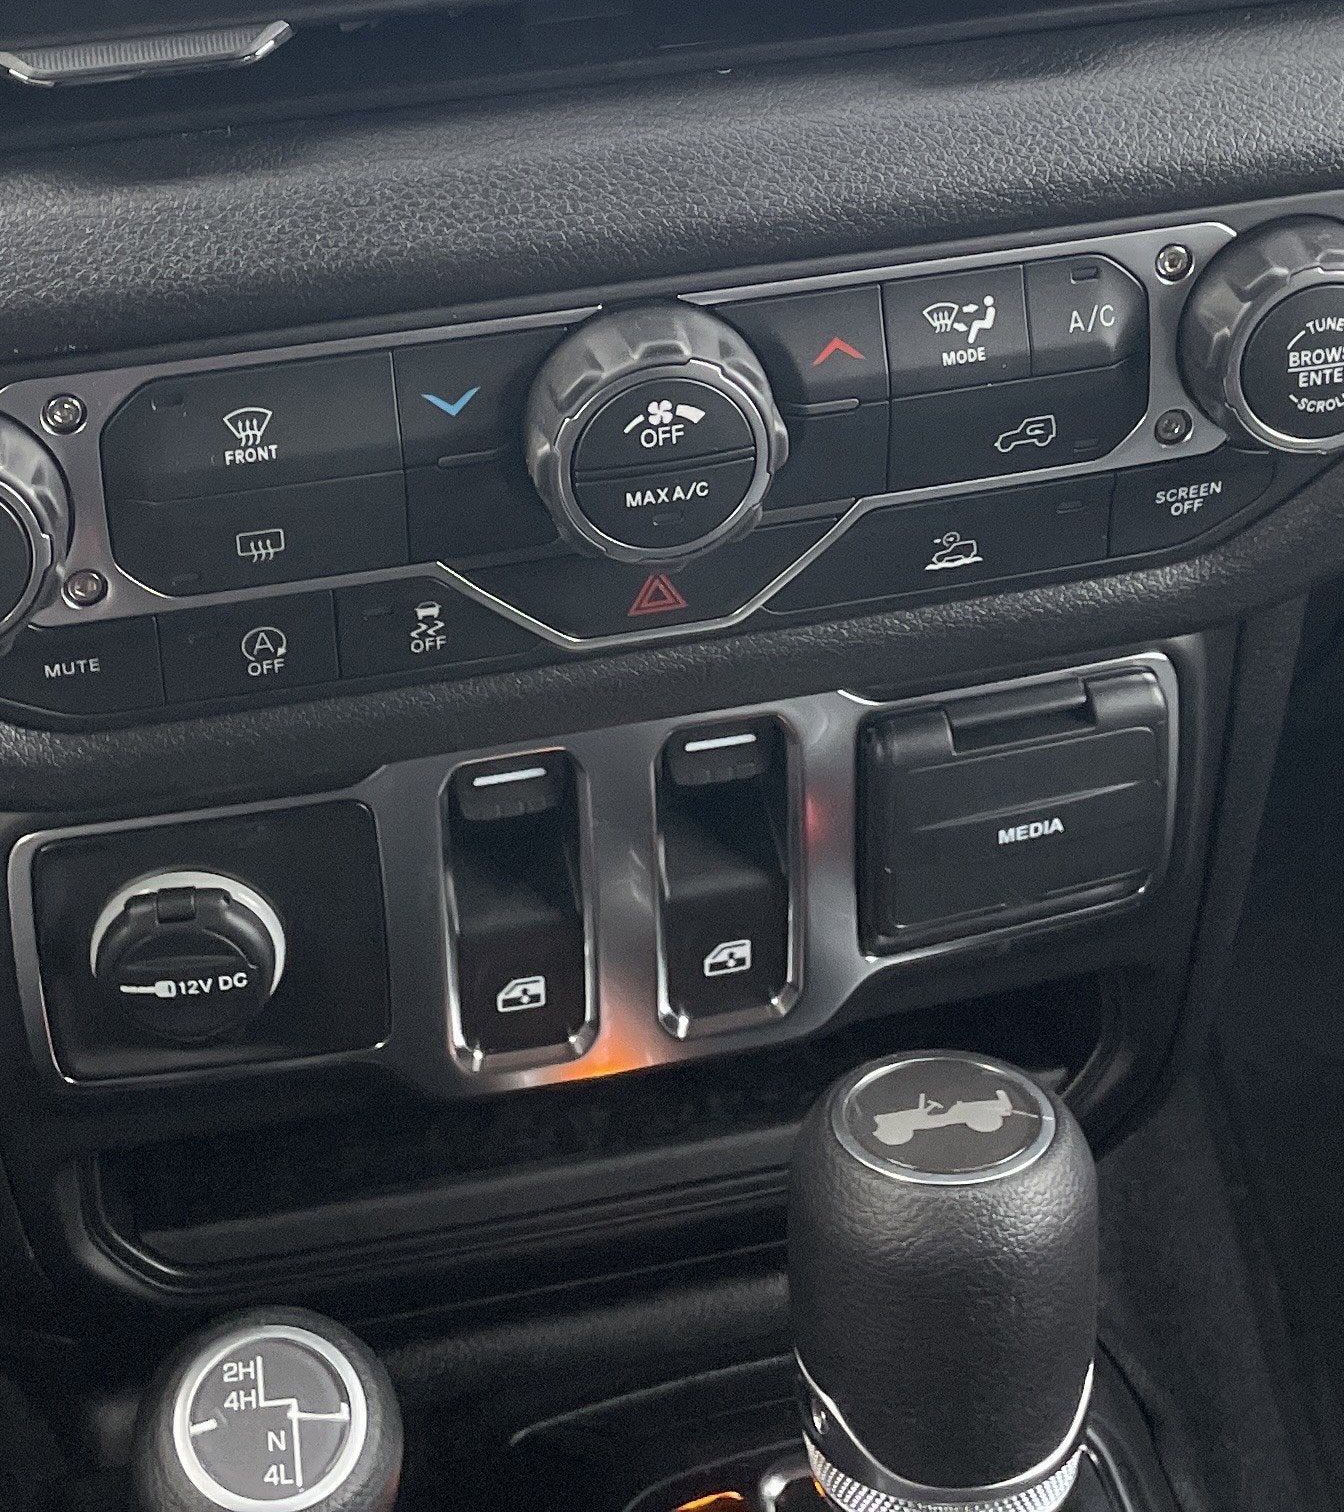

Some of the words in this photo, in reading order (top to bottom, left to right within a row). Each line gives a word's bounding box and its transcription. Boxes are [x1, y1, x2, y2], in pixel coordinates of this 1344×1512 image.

[1069, 304, 1115, 334] A/C
[942, 346, 986, 367] MODE
[640, 424, 684, 448] OFF
[224, 443, 279, 466] FRONT
[625, 487, 669, 508] MAX
[672, 481, 709, 501] A/C
[1156, 481, 1222, 504] SCREEN
[1171, 498, 1203, 516] OFF
[410, 634, 446, 654] OFF
[44, 657, 101, 679] MUTE
[247, 657, 285, 678] OFF
[998, 818, 1064, 844] MEDIA
[178, 978, 213, 995] 12V
[218, 972, 248, 990] DC
[223, 1361, 255, 1382] 2H
[223, 1389, 256, 1411] 4H
[267, 1431, 285, 1452] N
[264, 1465, 293, 1486] 4L
